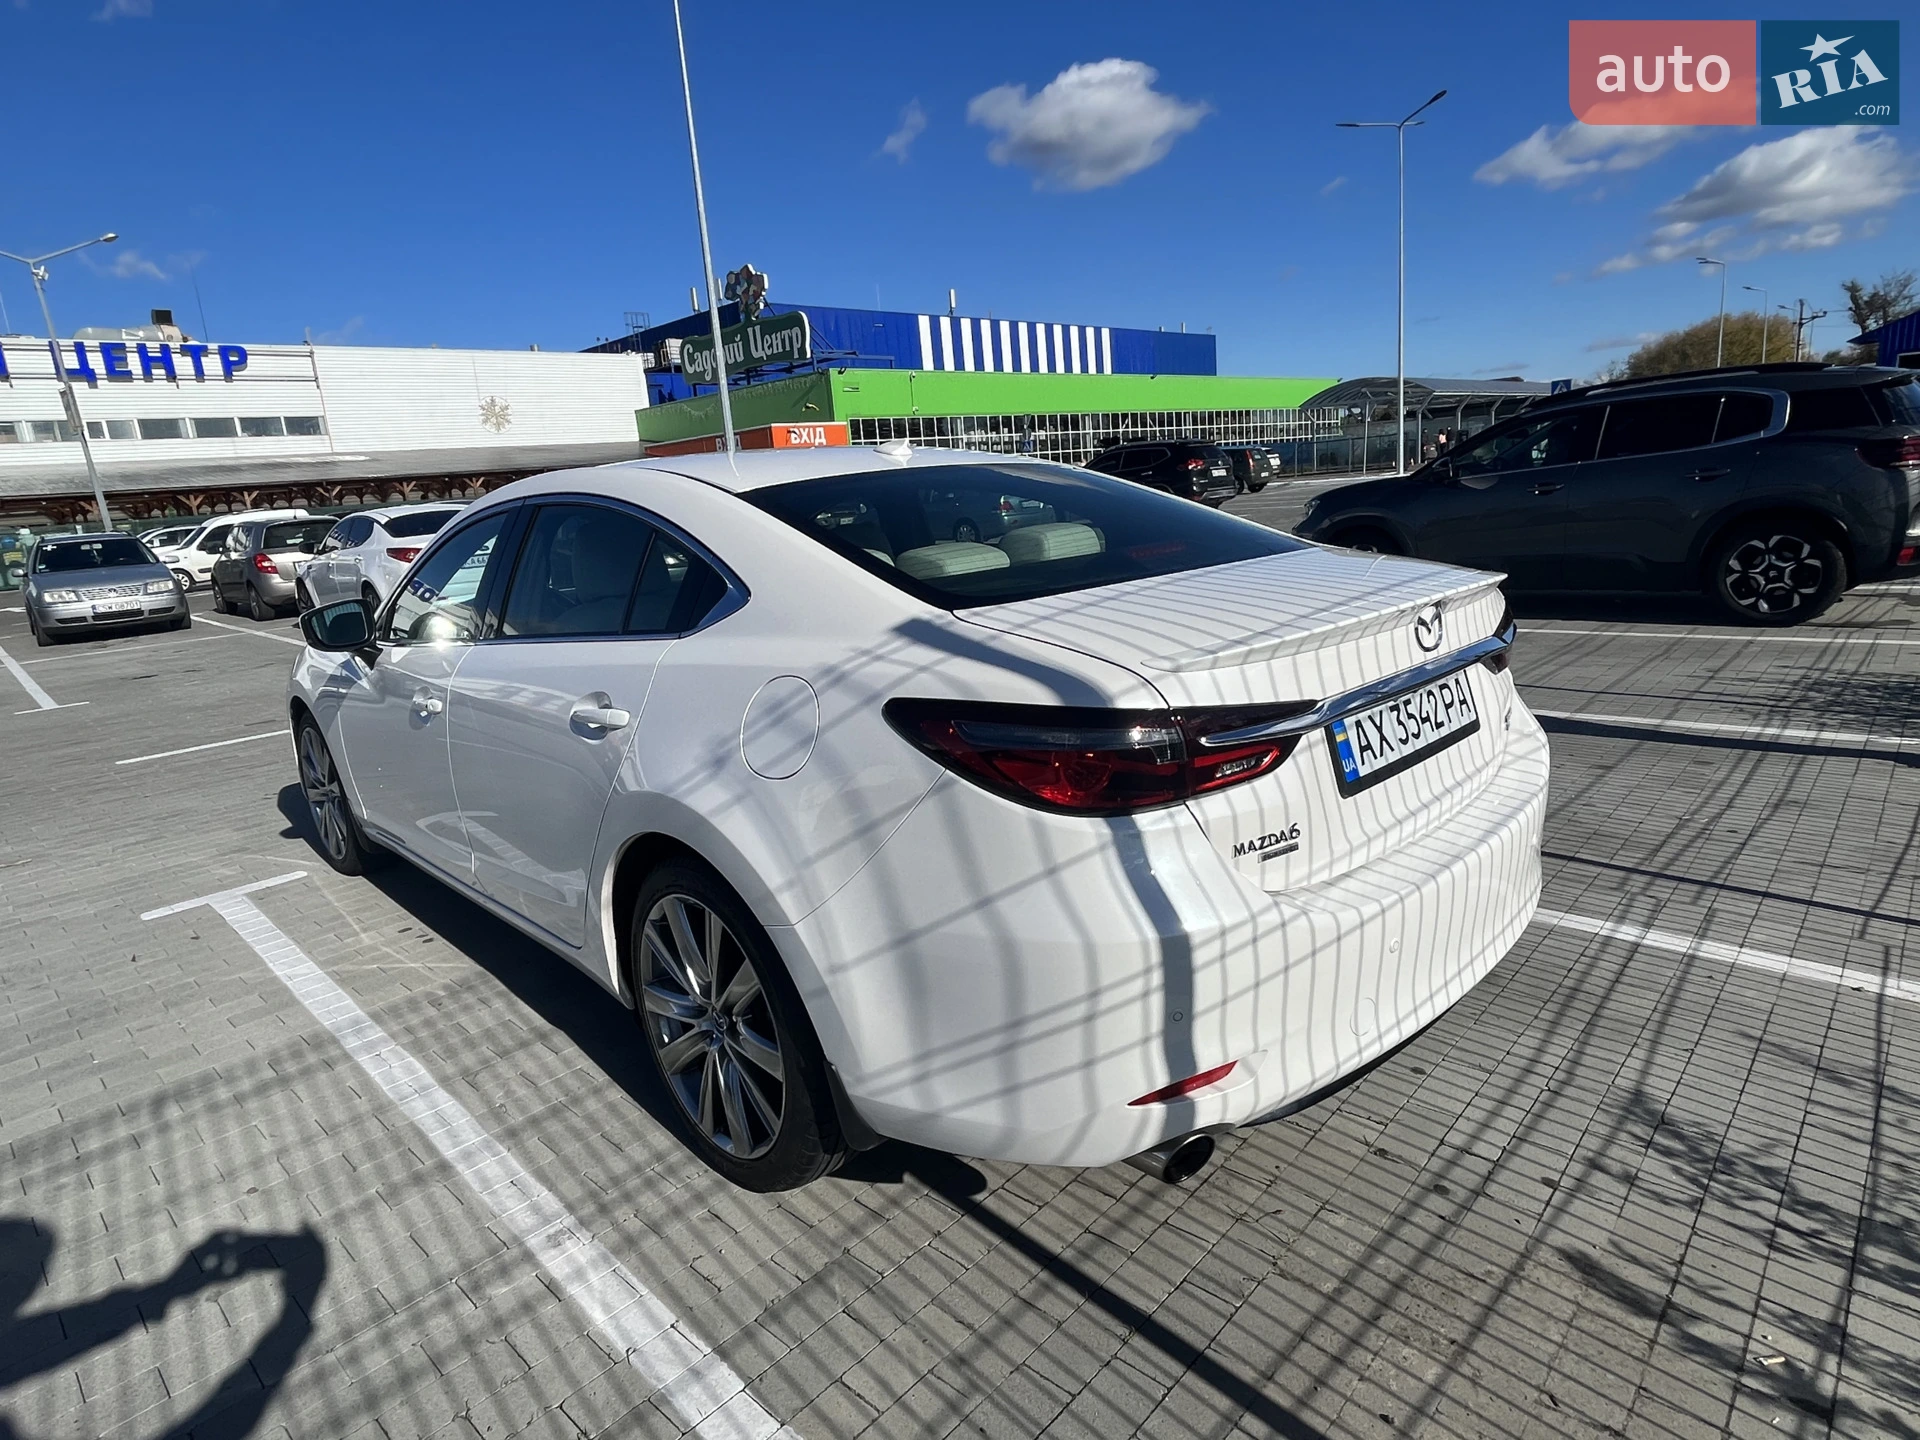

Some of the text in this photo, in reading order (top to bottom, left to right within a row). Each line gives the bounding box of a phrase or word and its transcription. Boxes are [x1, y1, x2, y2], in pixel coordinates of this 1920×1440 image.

[747, 324, 801, 361] Центр
[48, 341, 248, 385] ЦЕНТР
[790, 427, 827, 446] ВХІД
[1355, 709, 1395, 766] AX
[1389, 689, 1445, 746] 3542
[1438, 677, 1472, 724] PA
[1342, 758, 1357, 773] UA
